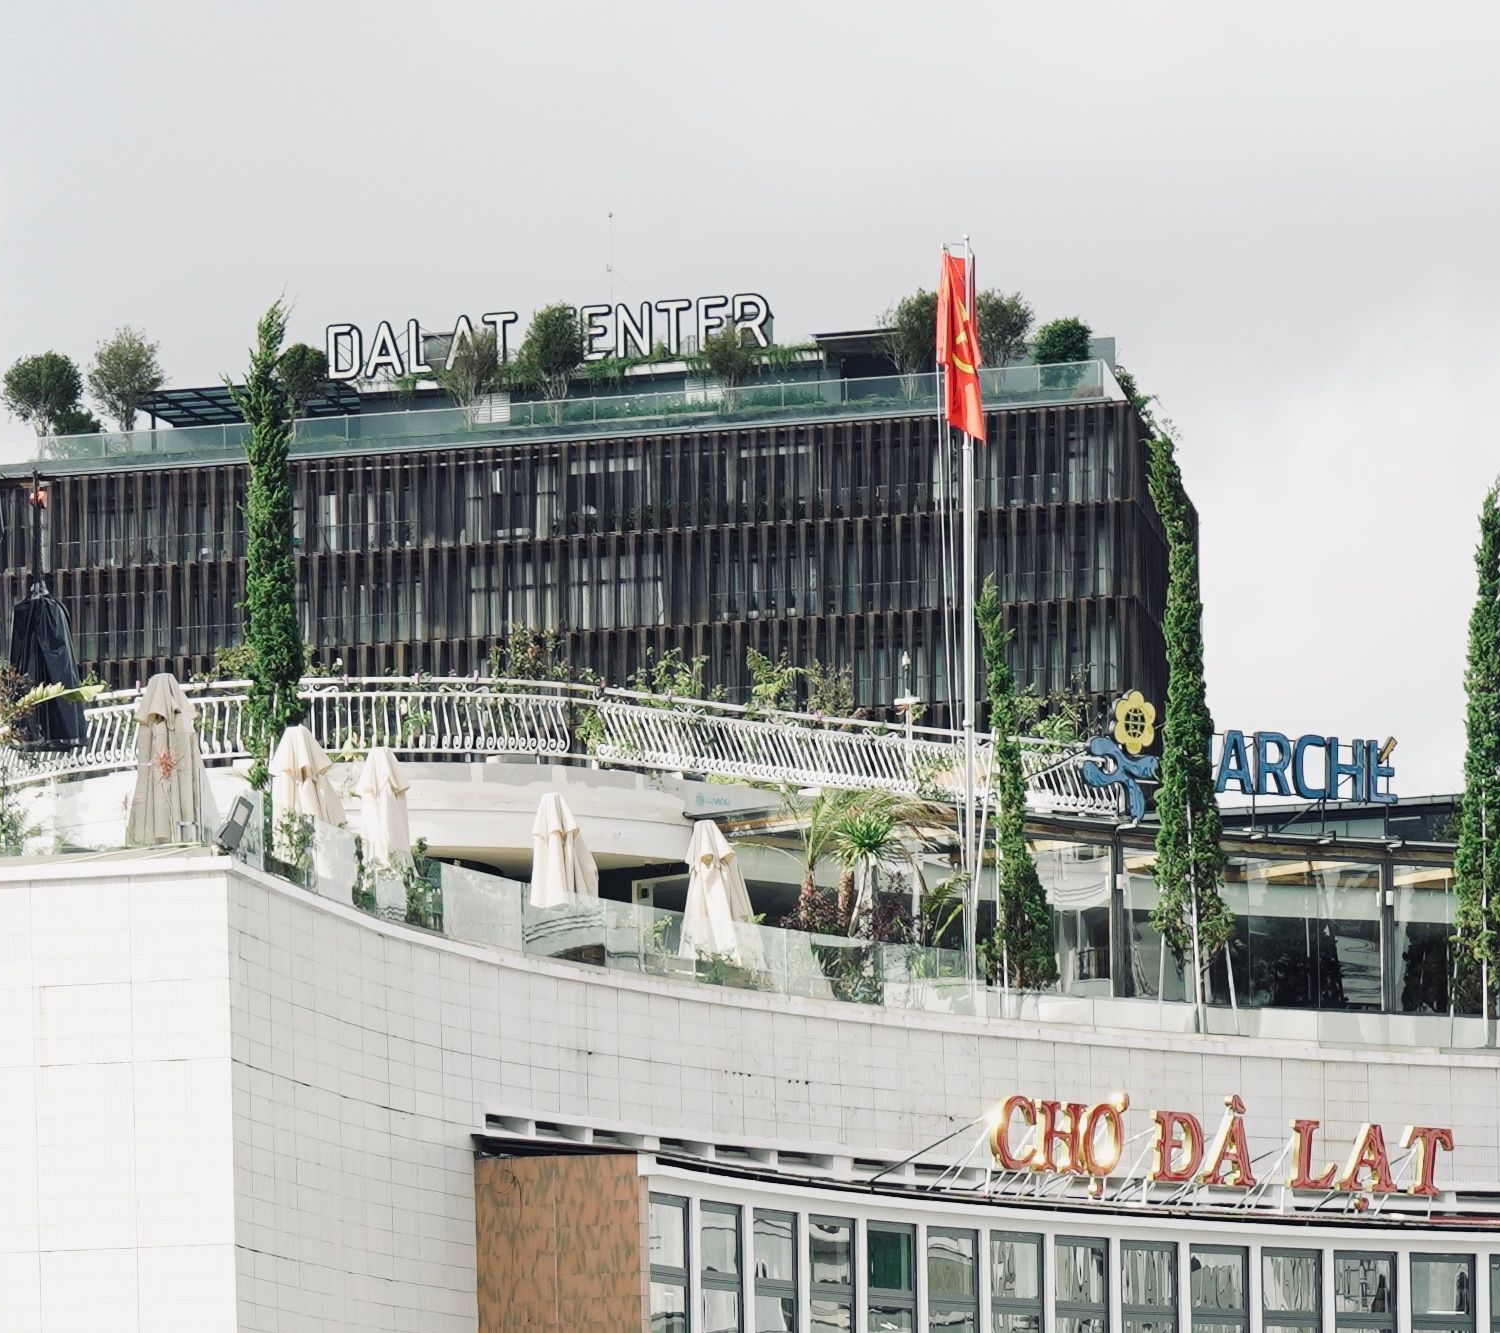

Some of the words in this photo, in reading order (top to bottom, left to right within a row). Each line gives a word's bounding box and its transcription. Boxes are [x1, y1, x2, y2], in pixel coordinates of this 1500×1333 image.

[566, 293, 770, 361] ENTER
[1207, 729, 1398, 804] ARCHÉ
[988, 1091, 1131, 1199] CHỢ
[1149, 1093, 1258, 1188] ĐÀ
[1286, 1119, 1455, 1213] LẠT
